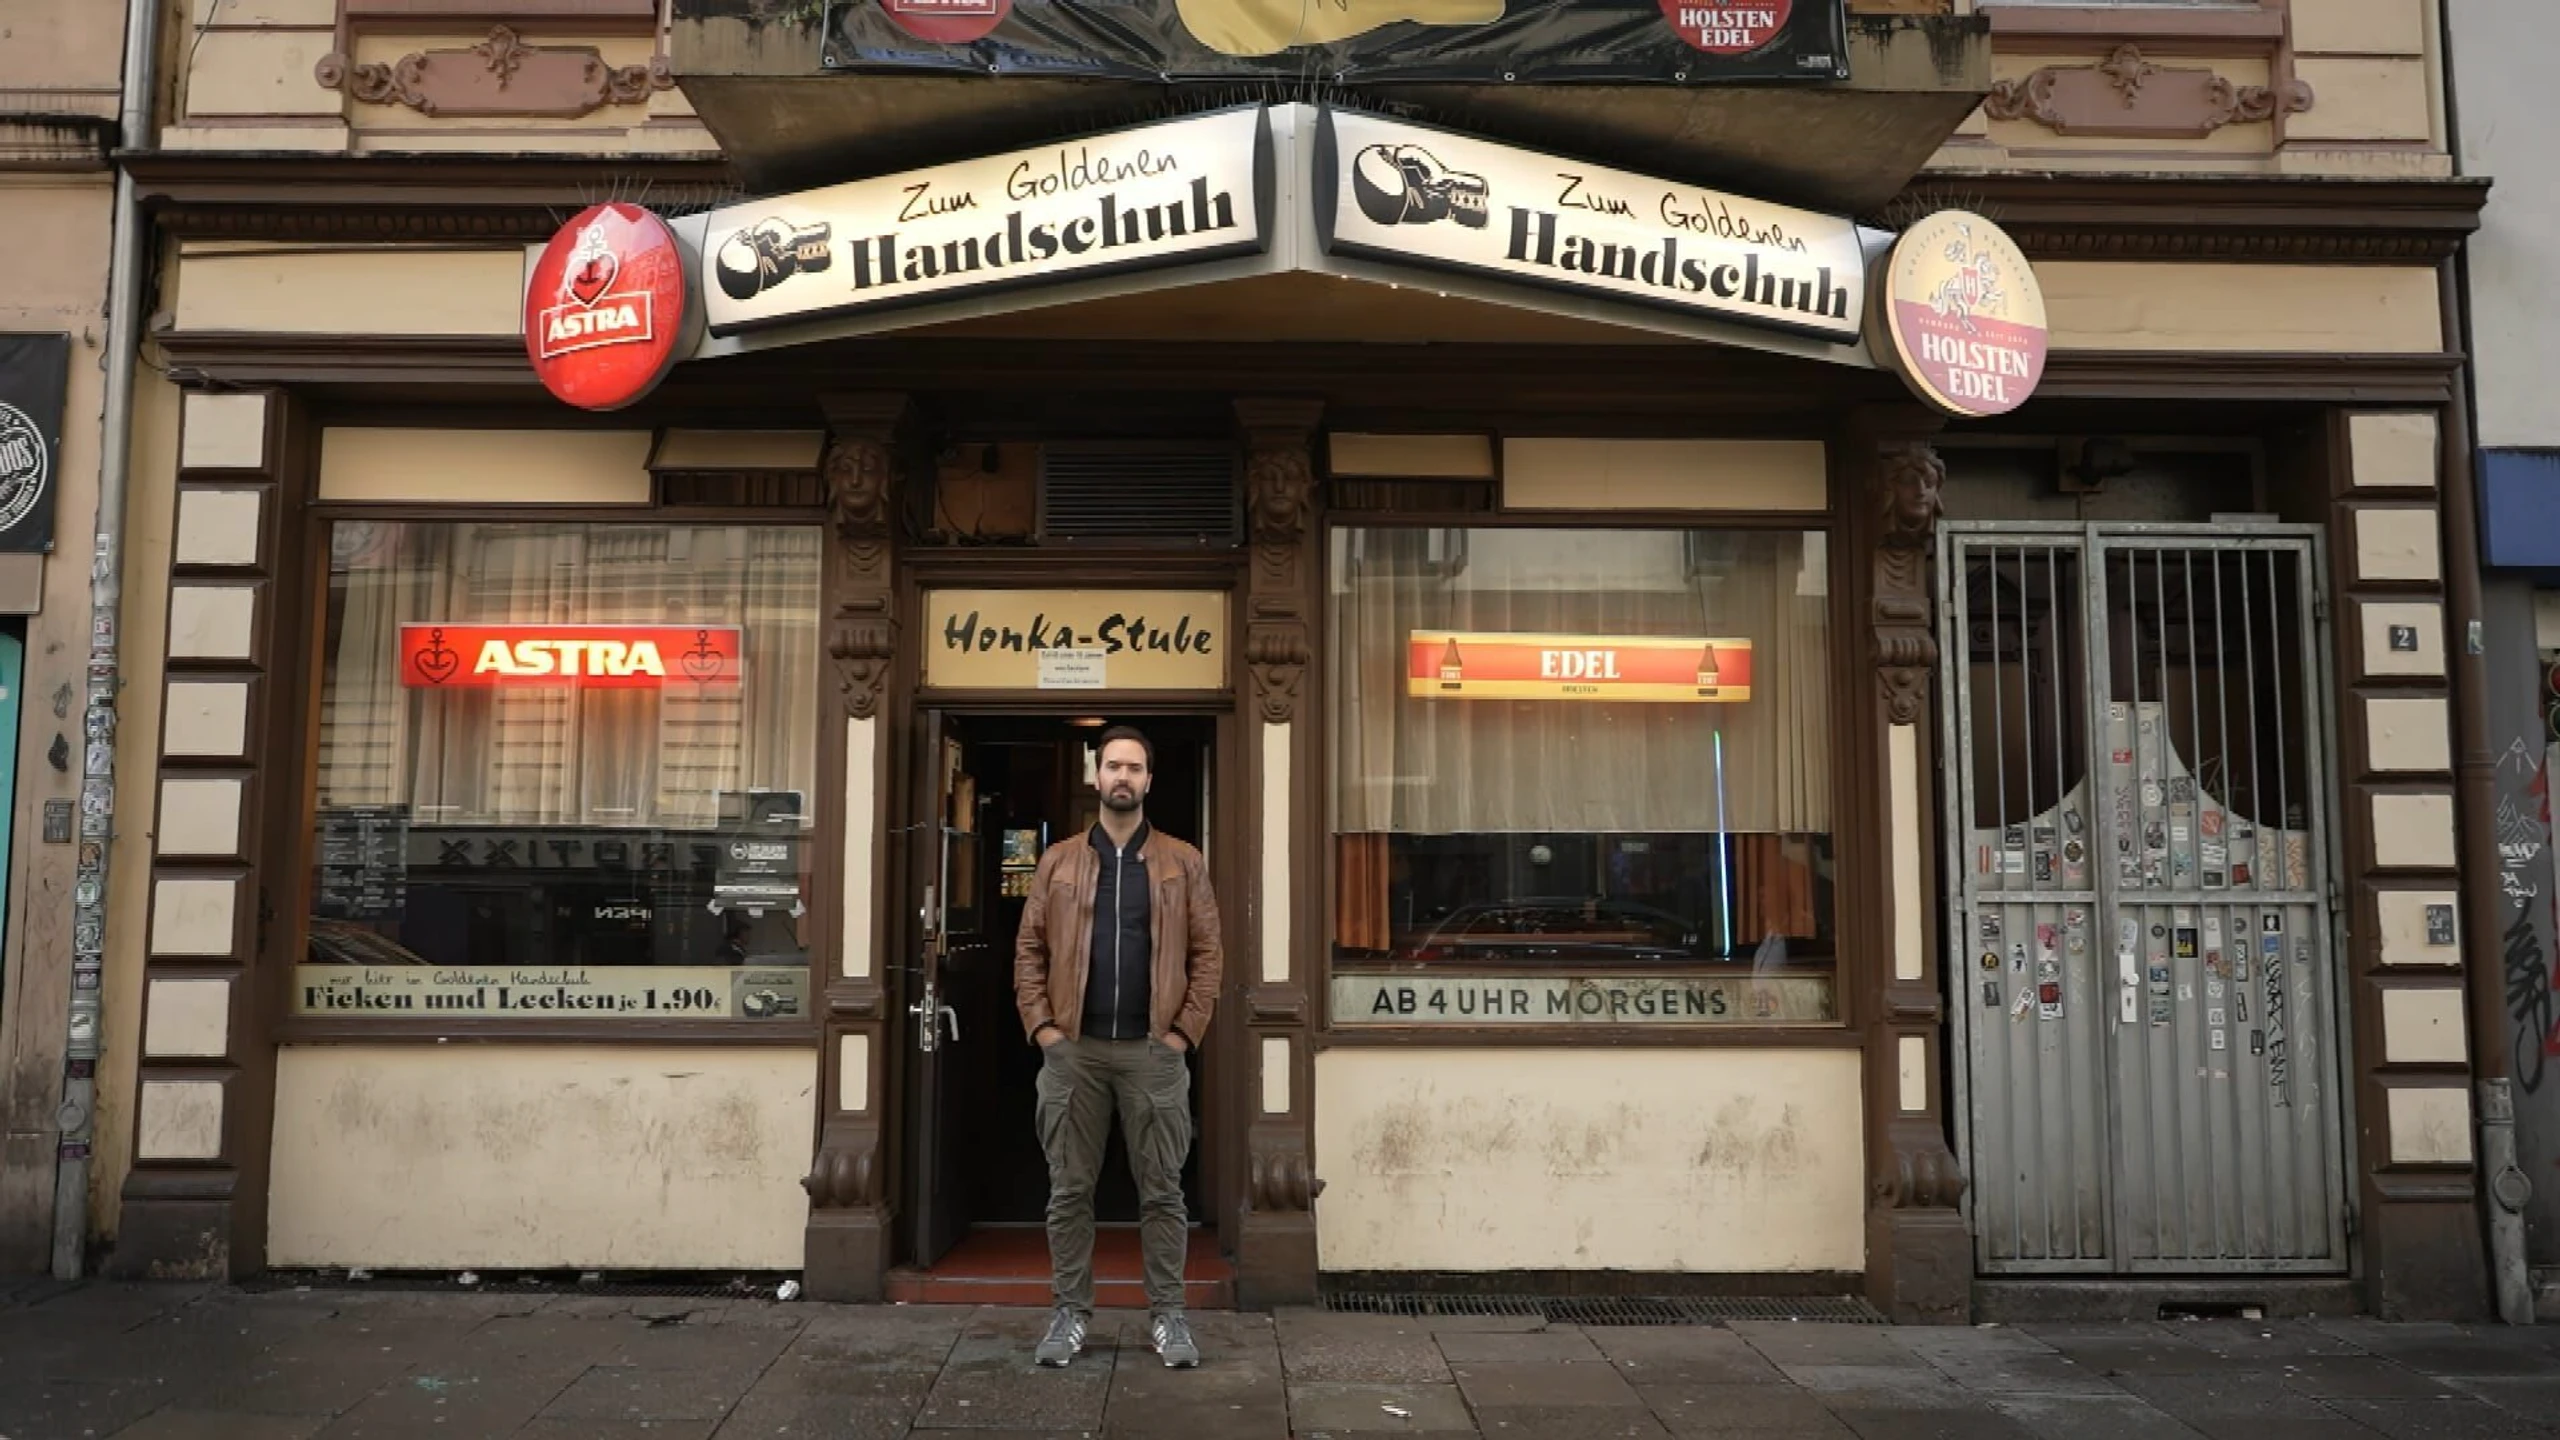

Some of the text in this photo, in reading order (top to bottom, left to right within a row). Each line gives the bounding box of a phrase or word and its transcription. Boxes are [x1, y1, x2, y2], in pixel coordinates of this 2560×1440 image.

[1679, 8, 1774, 28] HOLSTEN
[1701, 29, 1755, 47] EDEL
[898, 146, 1178, 223] Zum Goldenen
[1556, 173, 1808, 254] Zum Goldenen
[849, 175, 1239, 292] Handschuh
[1504, 205, 1849, 320] Handschuh
[547, 304, 640, 343] ASTRA
[1921, 332, 2030, 378] HOLSTEN
[1948, 367, 2010, 404] EDEL
[944, 610, 1212, 655] Honka-Stube
[473, 639, 667, 676] ASTRA
[1540, 650, 1621, 679] EDEL
[424, 987, 486, 1009] und
[1371, 987, 1727, 1016] AB 4 UHR MORGENS
